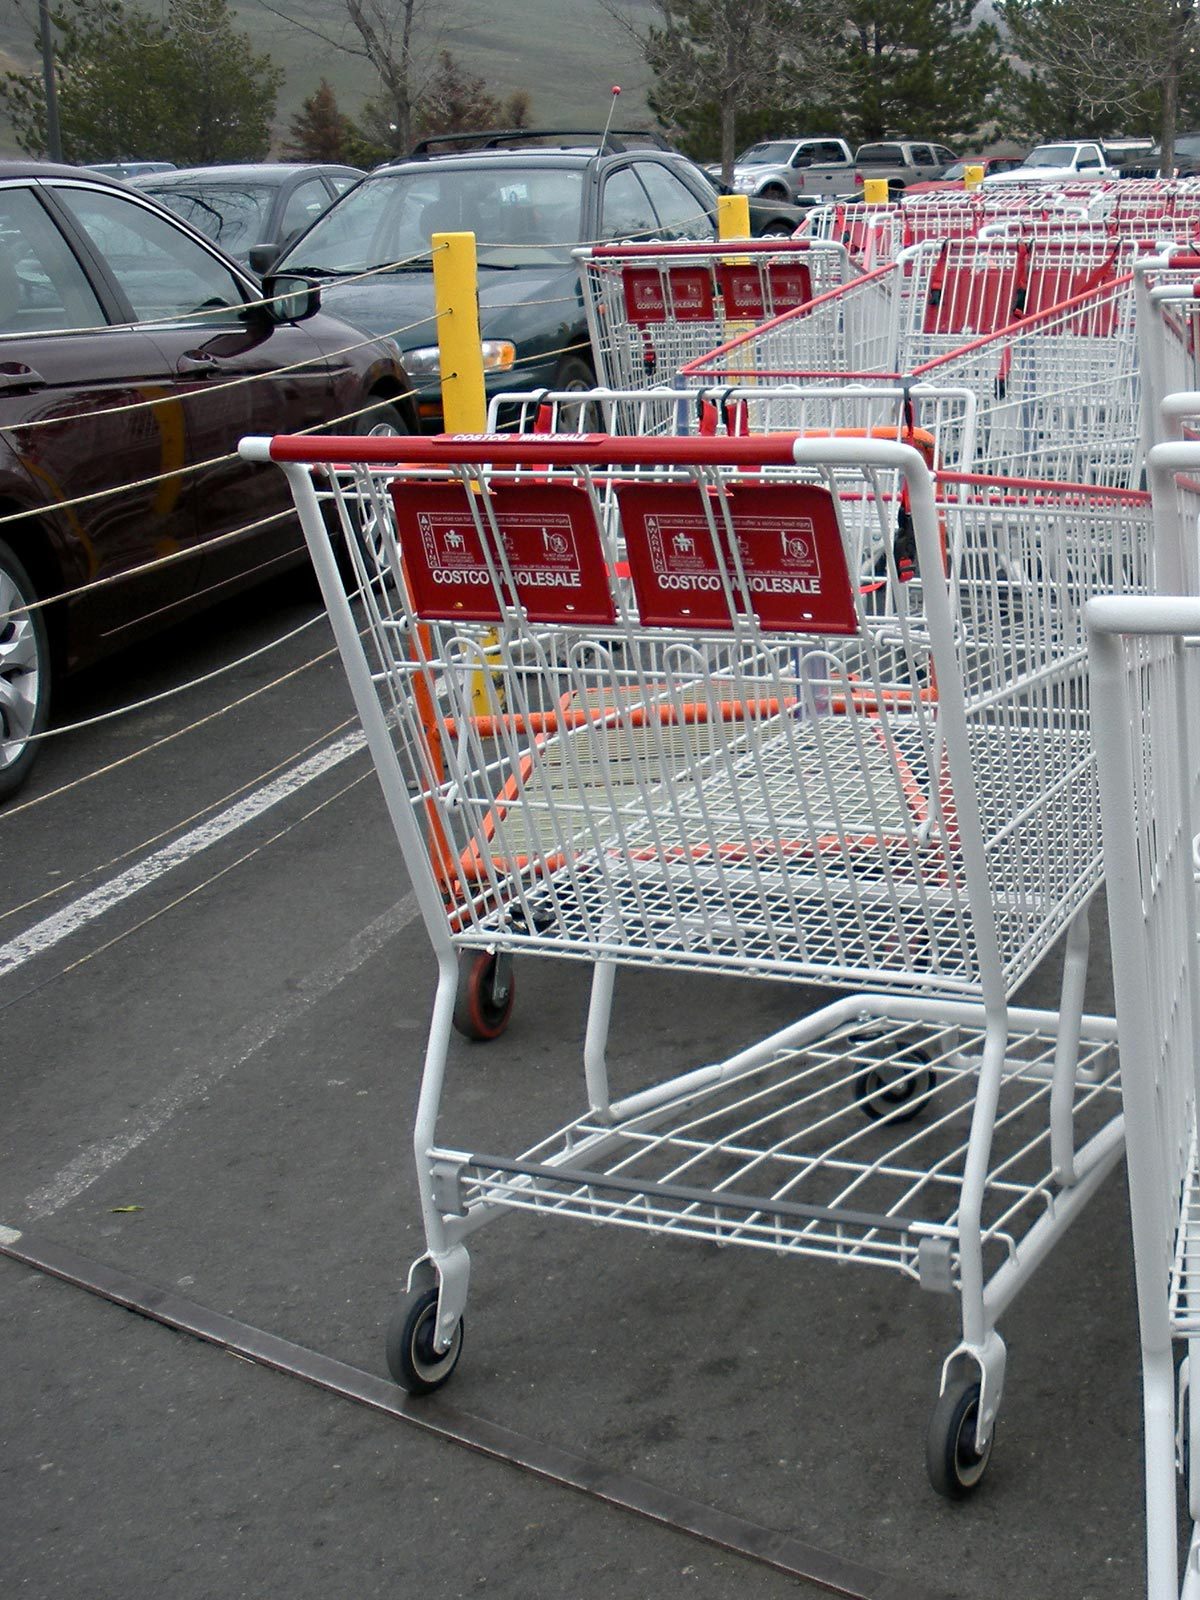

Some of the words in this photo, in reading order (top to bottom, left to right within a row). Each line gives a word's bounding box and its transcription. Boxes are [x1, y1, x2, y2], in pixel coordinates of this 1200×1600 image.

[452, 433, 510, 442] COSTCO
[518, 433, 589, 442] WHOLESALE
[432, 569, 489, 585] COSTCO
[657, 574, 721, 591] COSTCO
